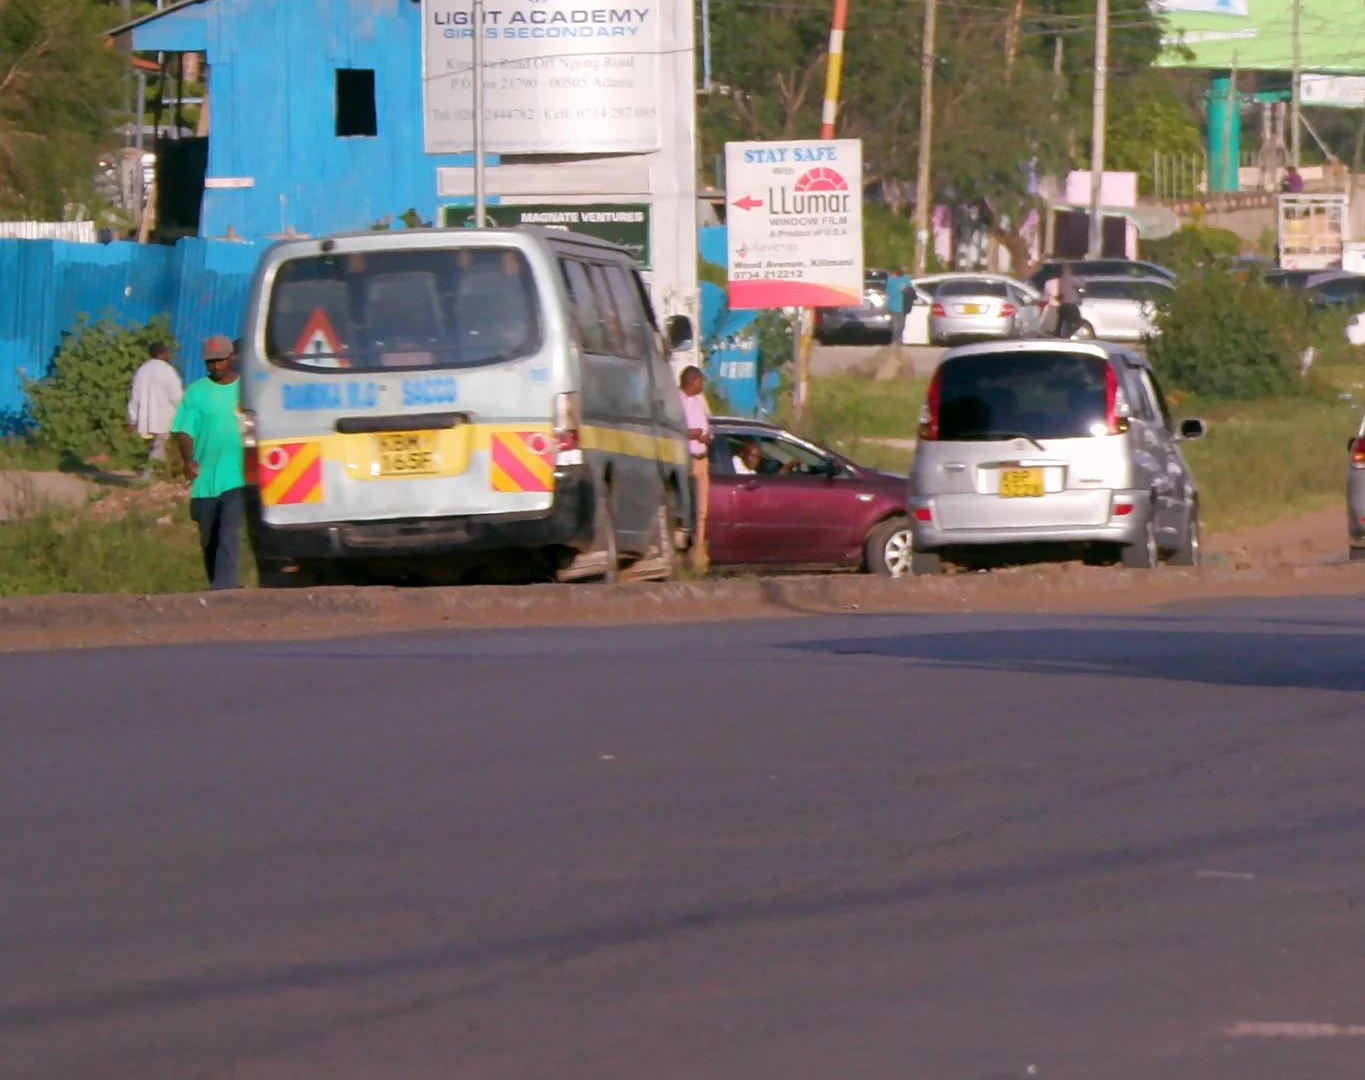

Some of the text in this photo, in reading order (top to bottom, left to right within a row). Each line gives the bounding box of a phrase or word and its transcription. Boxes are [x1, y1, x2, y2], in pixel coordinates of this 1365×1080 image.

[510, 9, 650, 24] ACADEMY
[504, 26, 638, 38] SECONDARY
[604, 56, 635, 67] Road
[744, 147, 837, 163] STAY SAFE
[768, 186, 850, 215] LLumar
[520, 212, 644, 223] MAGNATE VENTURES
[769, 217, 848, 226] WINDOW FILM
[734, 261, 762, 269] Wood
